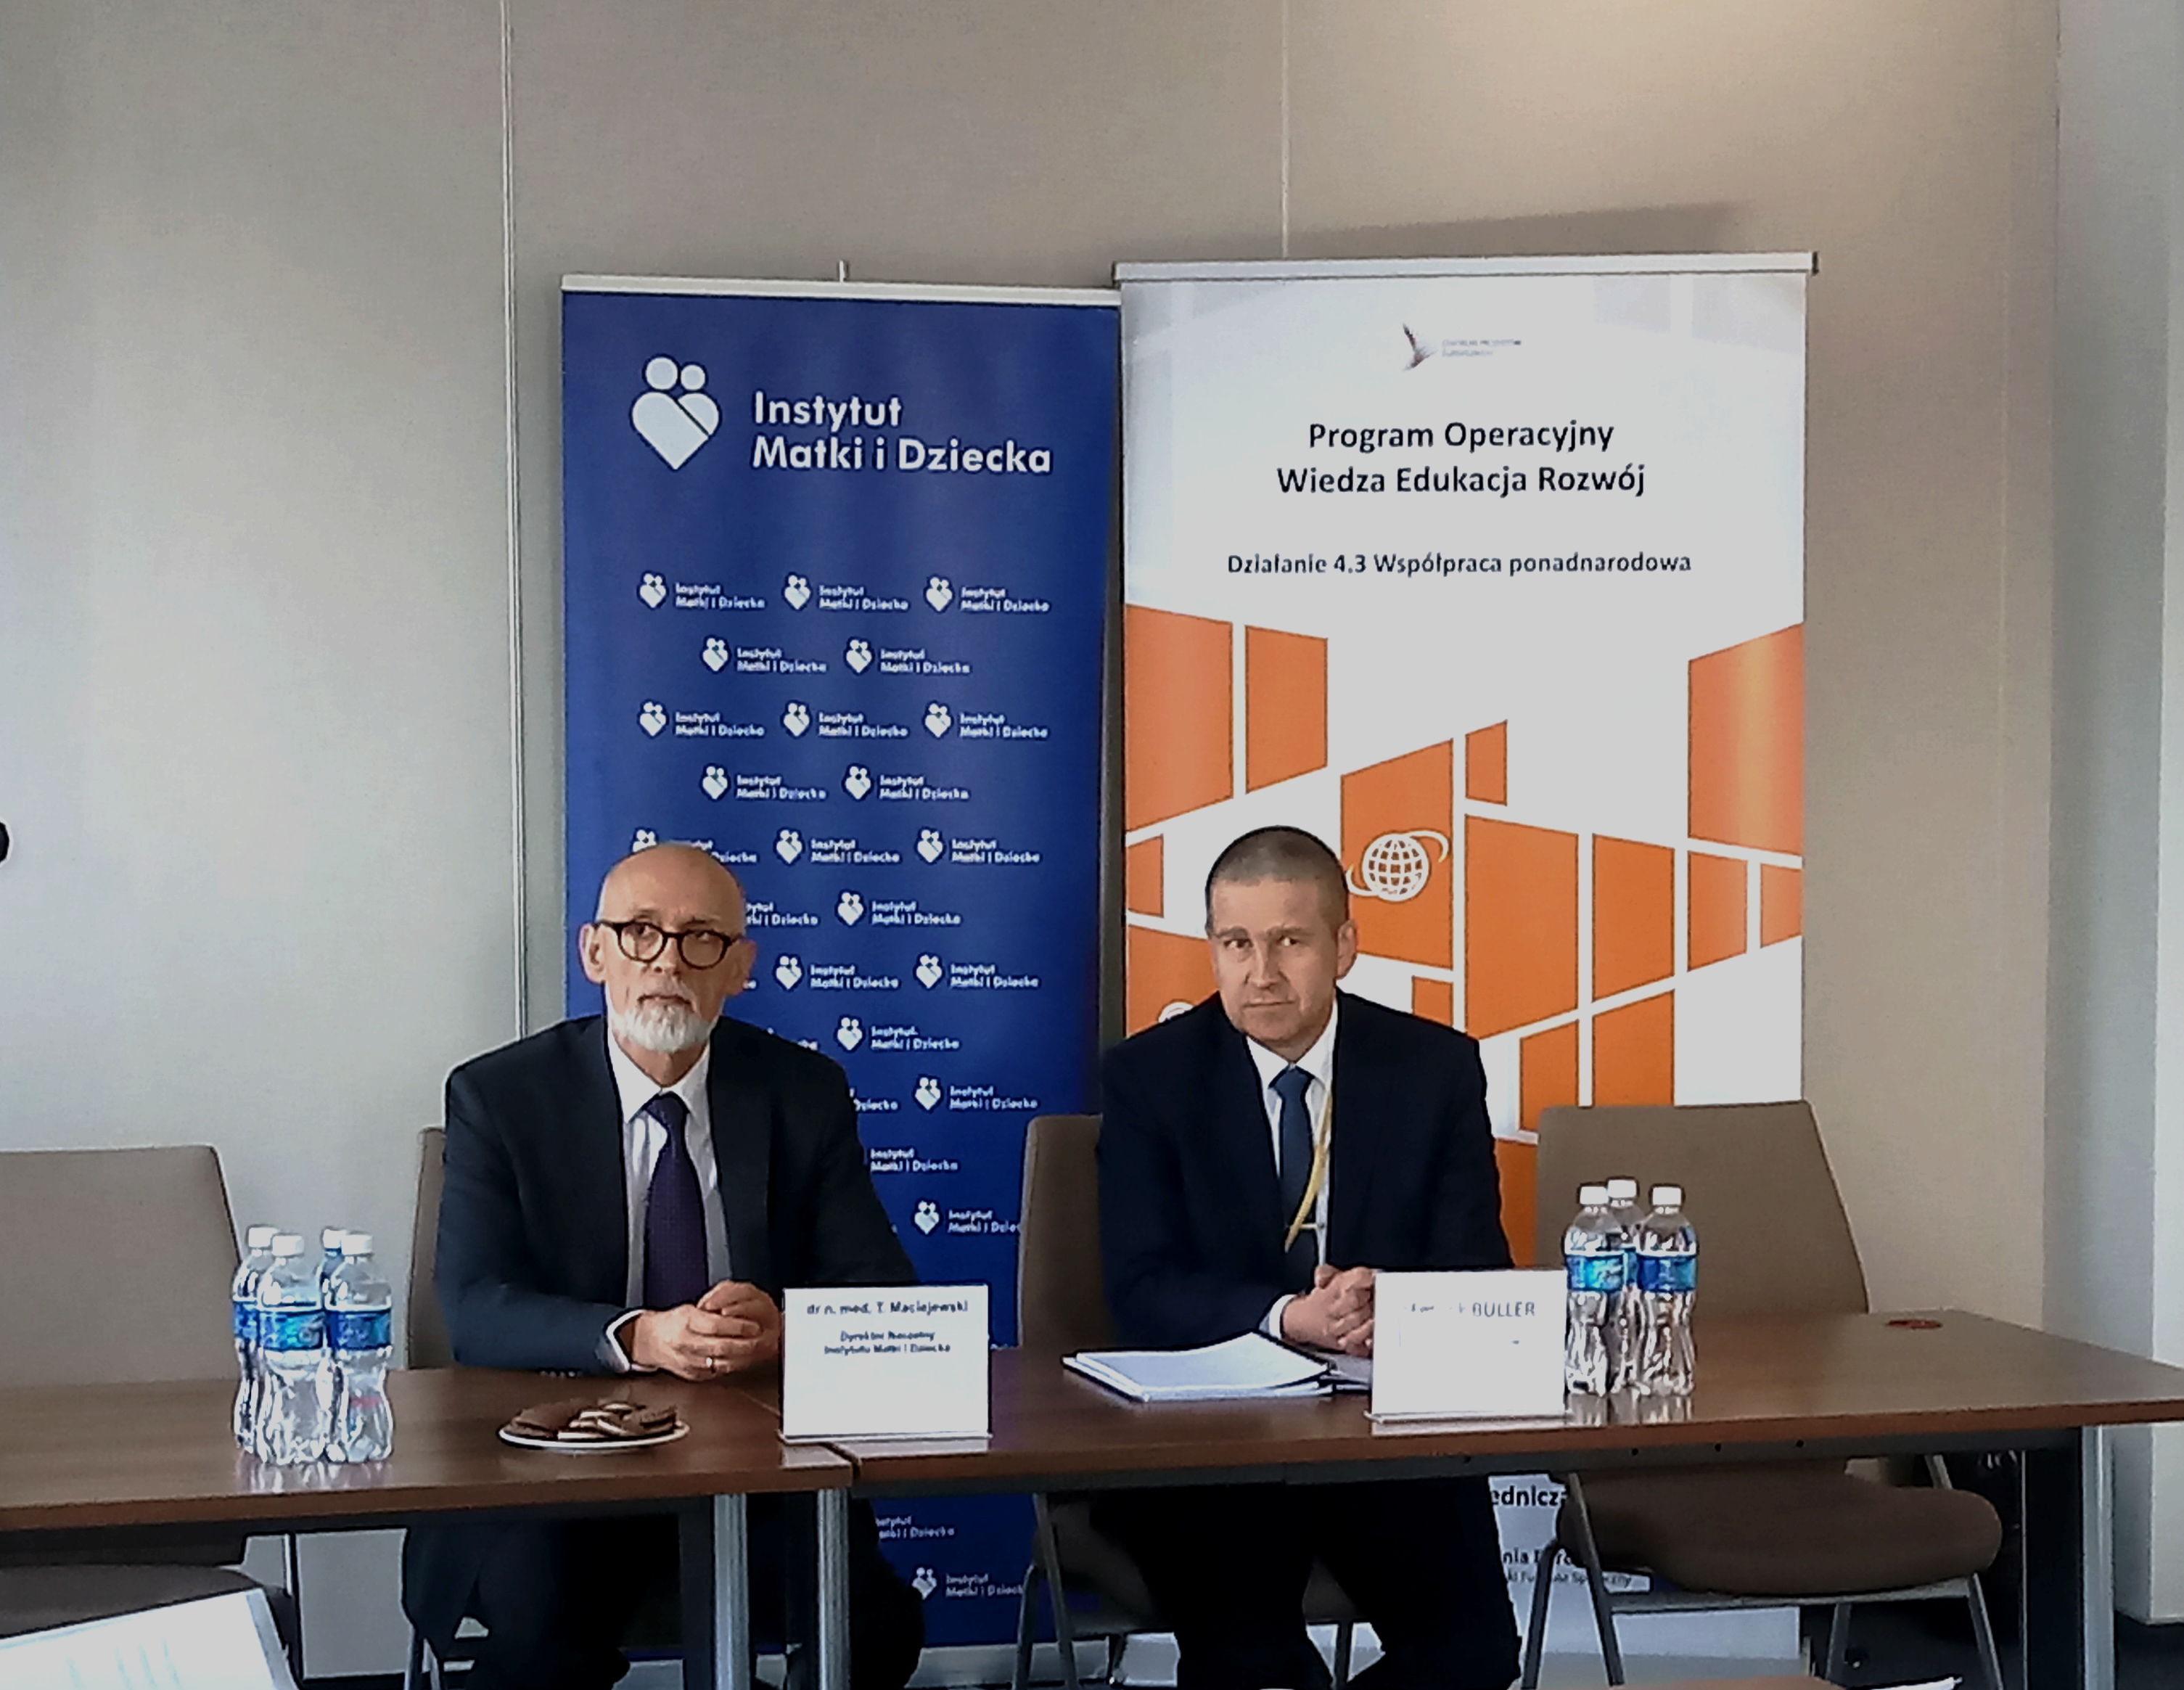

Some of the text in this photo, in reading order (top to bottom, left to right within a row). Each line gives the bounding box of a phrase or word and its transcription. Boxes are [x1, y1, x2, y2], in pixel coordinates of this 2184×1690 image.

[755, 391, 901, 432] Instytut
[753, 435, 1050, 472] Matki i Dziecka
[1310, 419, 1614, 455] Program Operacyjny
[1276, 462, 1645, 499] Wiedza Edukacja Rozwój
[1228, 550, 1692, 578] Działanie 4.3 Współpraca ponadnarodowa
[990, 1220, 1017, 1234] Dzie
